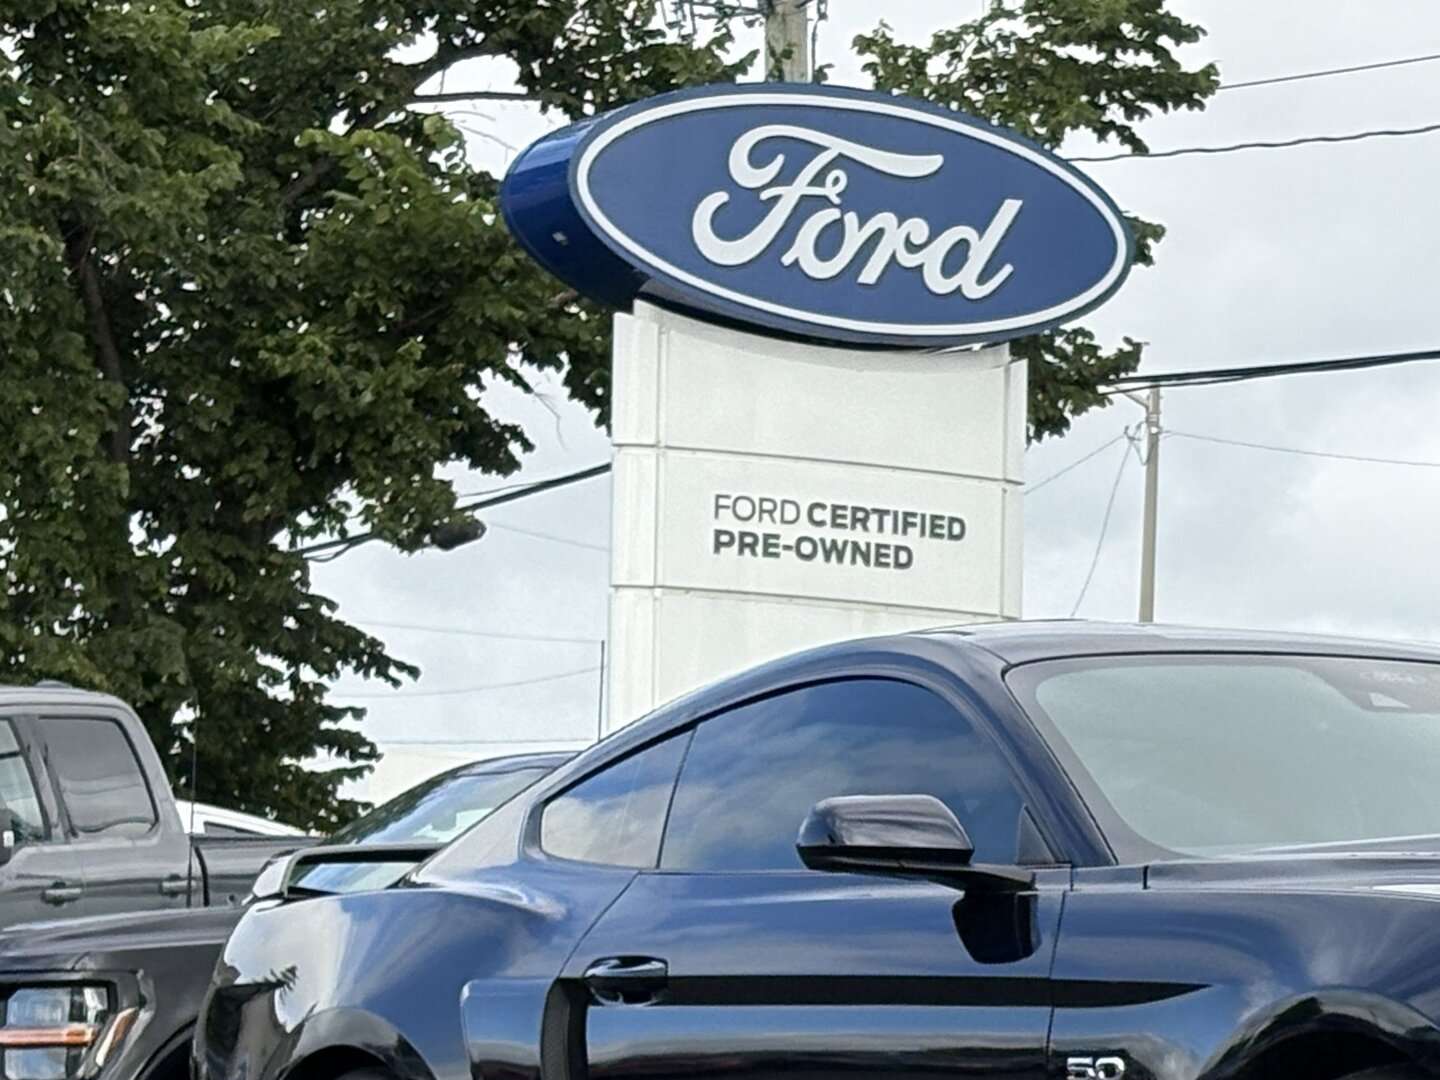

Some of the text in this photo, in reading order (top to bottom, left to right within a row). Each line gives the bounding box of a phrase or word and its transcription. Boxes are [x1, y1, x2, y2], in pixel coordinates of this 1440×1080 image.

[692, 124, 1023, 300] Ford
[714, 494, 966, 541] FORD CERTIFIED
[713, 529, 914, 570] PRE-OWNED
